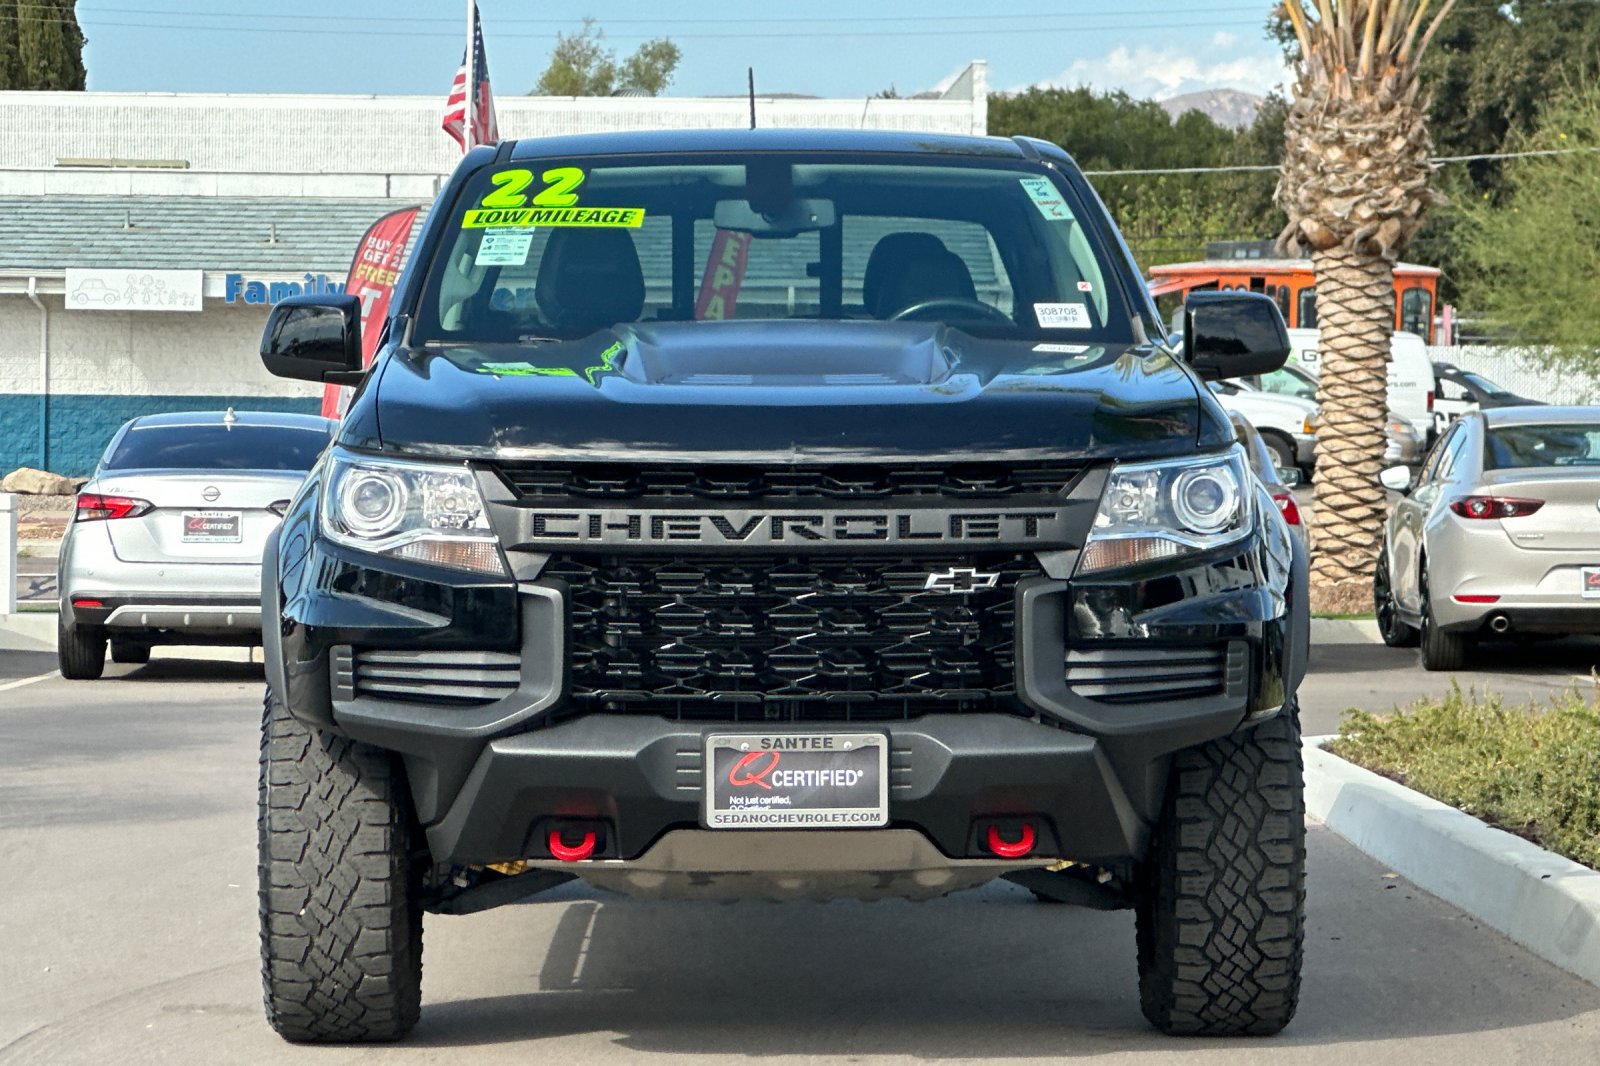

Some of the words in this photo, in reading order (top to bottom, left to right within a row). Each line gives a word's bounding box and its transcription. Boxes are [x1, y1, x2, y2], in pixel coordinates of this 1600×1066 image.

[482, 167, 585, 208] 22
[473, 210, 527, 224] LOW
[528, 210, 635, 224] MILEAGE
[368, 236, 393, 252] BUY
[396, 244, 404, 255] 2
[363, 249, 390, 266] GET
[391, 256, 399, 268] 2
[355, 263, 397, 287] FREE
[1038, 307, 1078, 316] 308708
[532, 512, 1058, 541] CHEVROLET
[761, 737, 833, 750] SANTEE
[730, 796, 744, 805] Not
[745, 796, 758, 806] just
[759, 796, 791, 805] certified,
[715, 813, 881, 824] SEDANOCHEVROLET.COM
